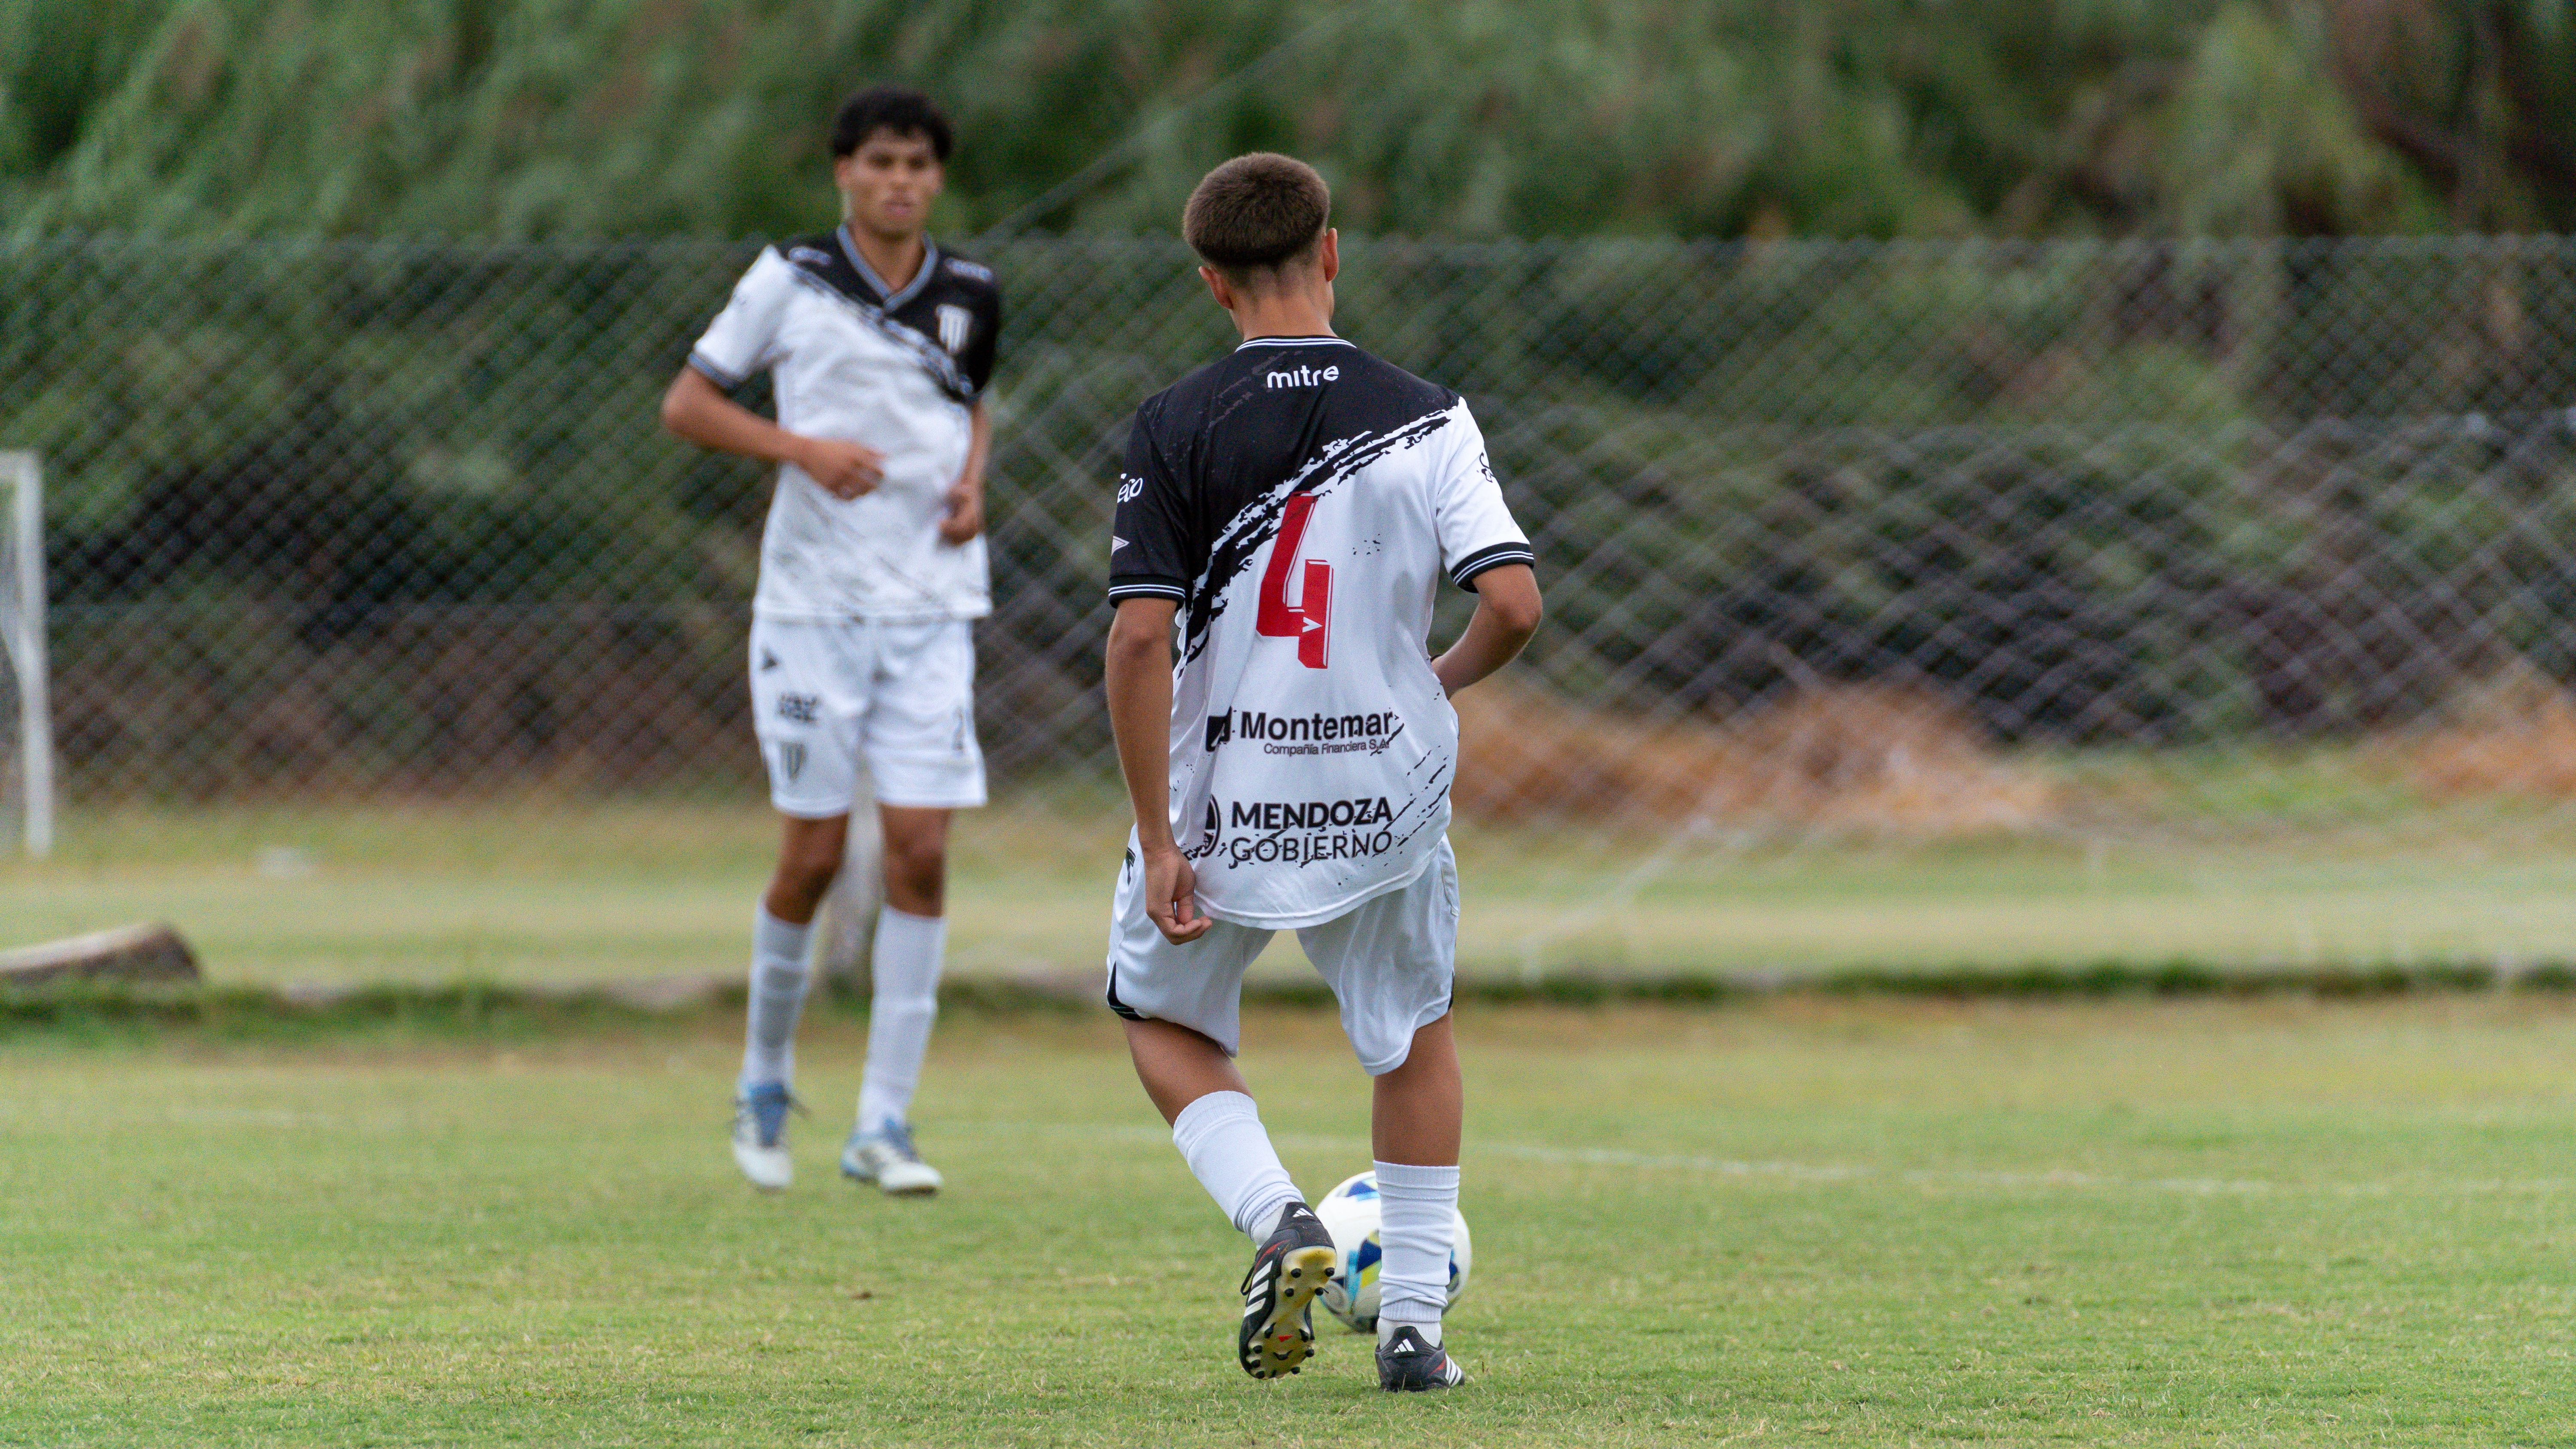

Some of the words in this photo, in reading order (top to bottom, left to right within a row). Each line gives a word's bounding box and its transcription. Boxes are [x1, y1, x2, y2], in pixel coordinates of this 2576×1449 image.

[1267, 365, 1339, 388] mitre
[1256, 491, 1334, 669] 4
[1240, 711, 1393, 740] Montemar
[1264, 743, 1318, 757] Compañía
[1321, 741, 1366, 754] Financiera
[1231, 797, 1393, 830] MENDOZA
[1230, 831, 1392, 862] GOBIERNO
